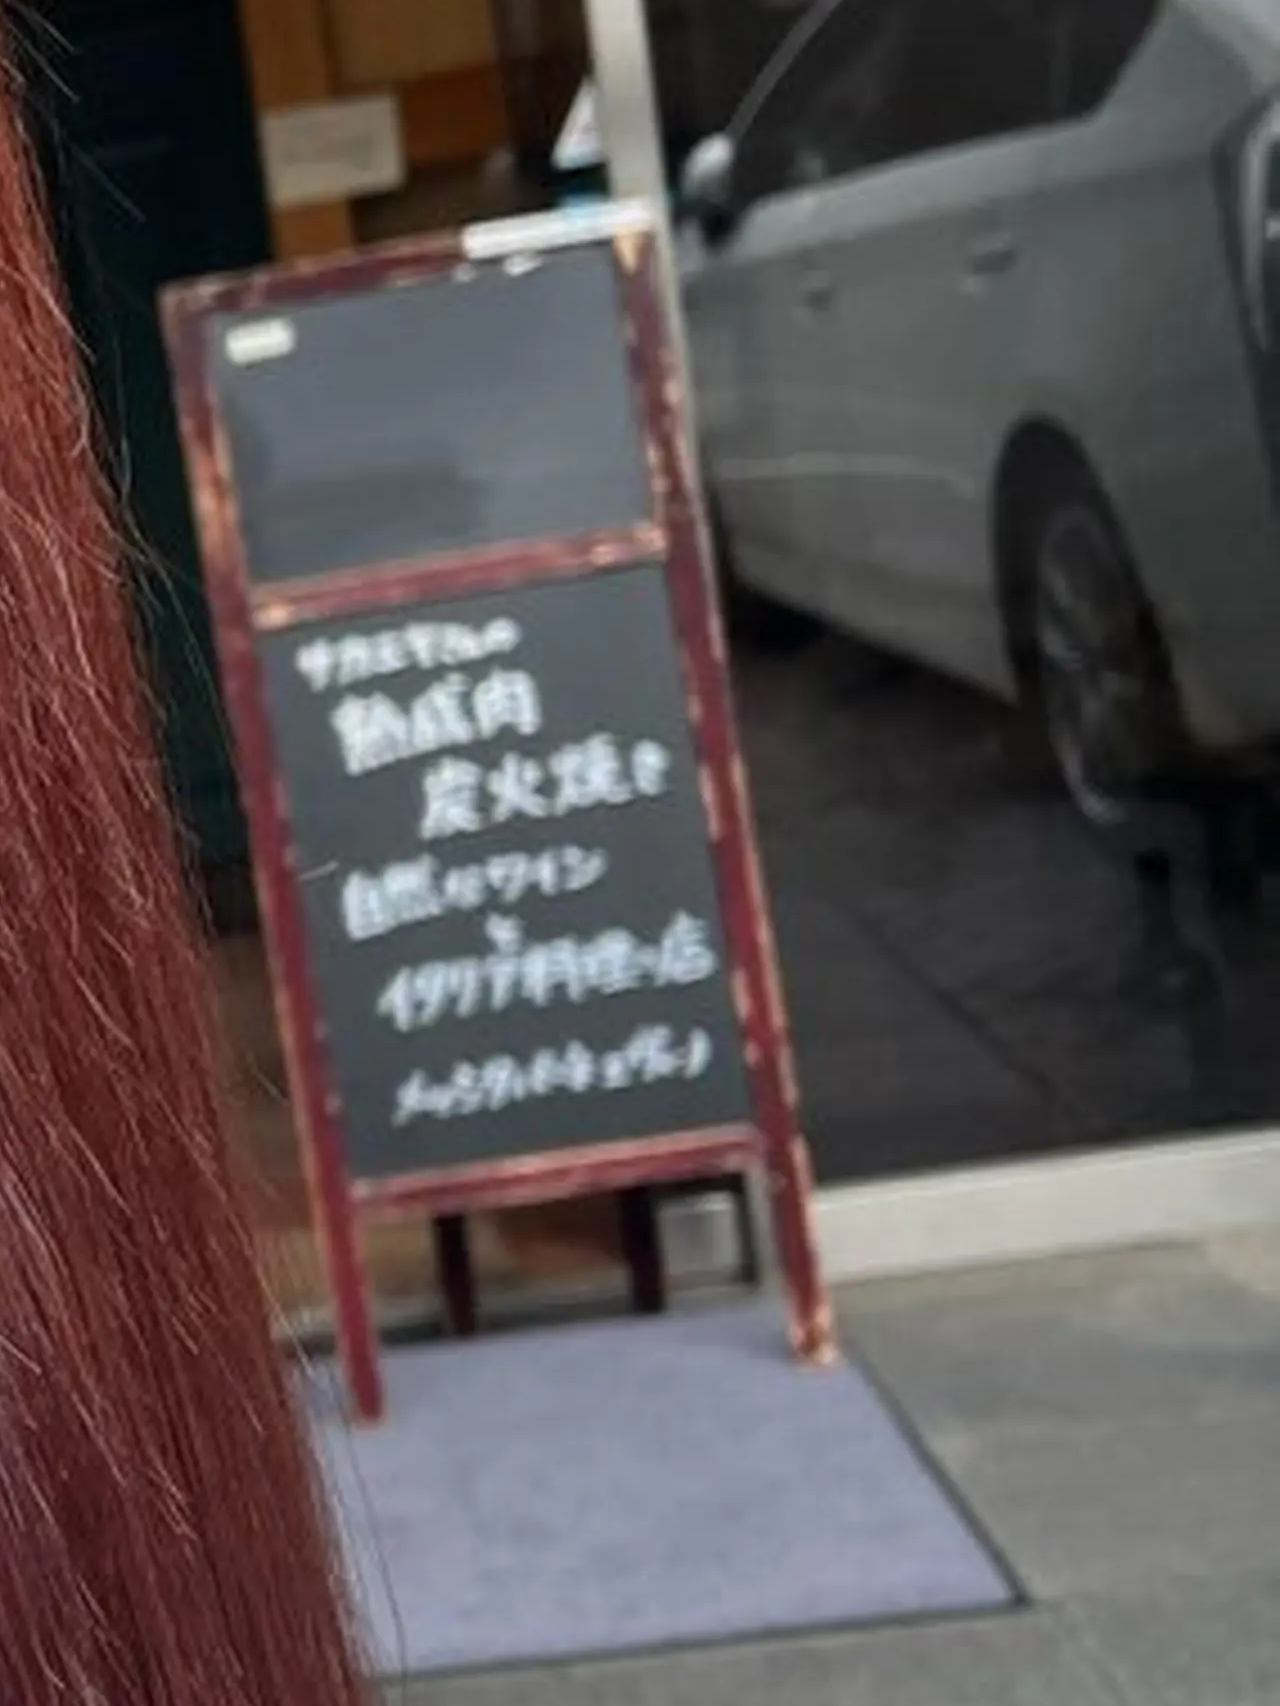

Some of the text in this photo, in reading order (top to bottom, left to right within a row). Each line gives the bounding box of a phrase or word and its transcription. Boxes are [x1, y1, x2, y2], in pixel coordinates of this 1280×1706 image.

[331, 667, 541, 776] 熟成肉
[419, 731, 670, 840] 炭火焼き
